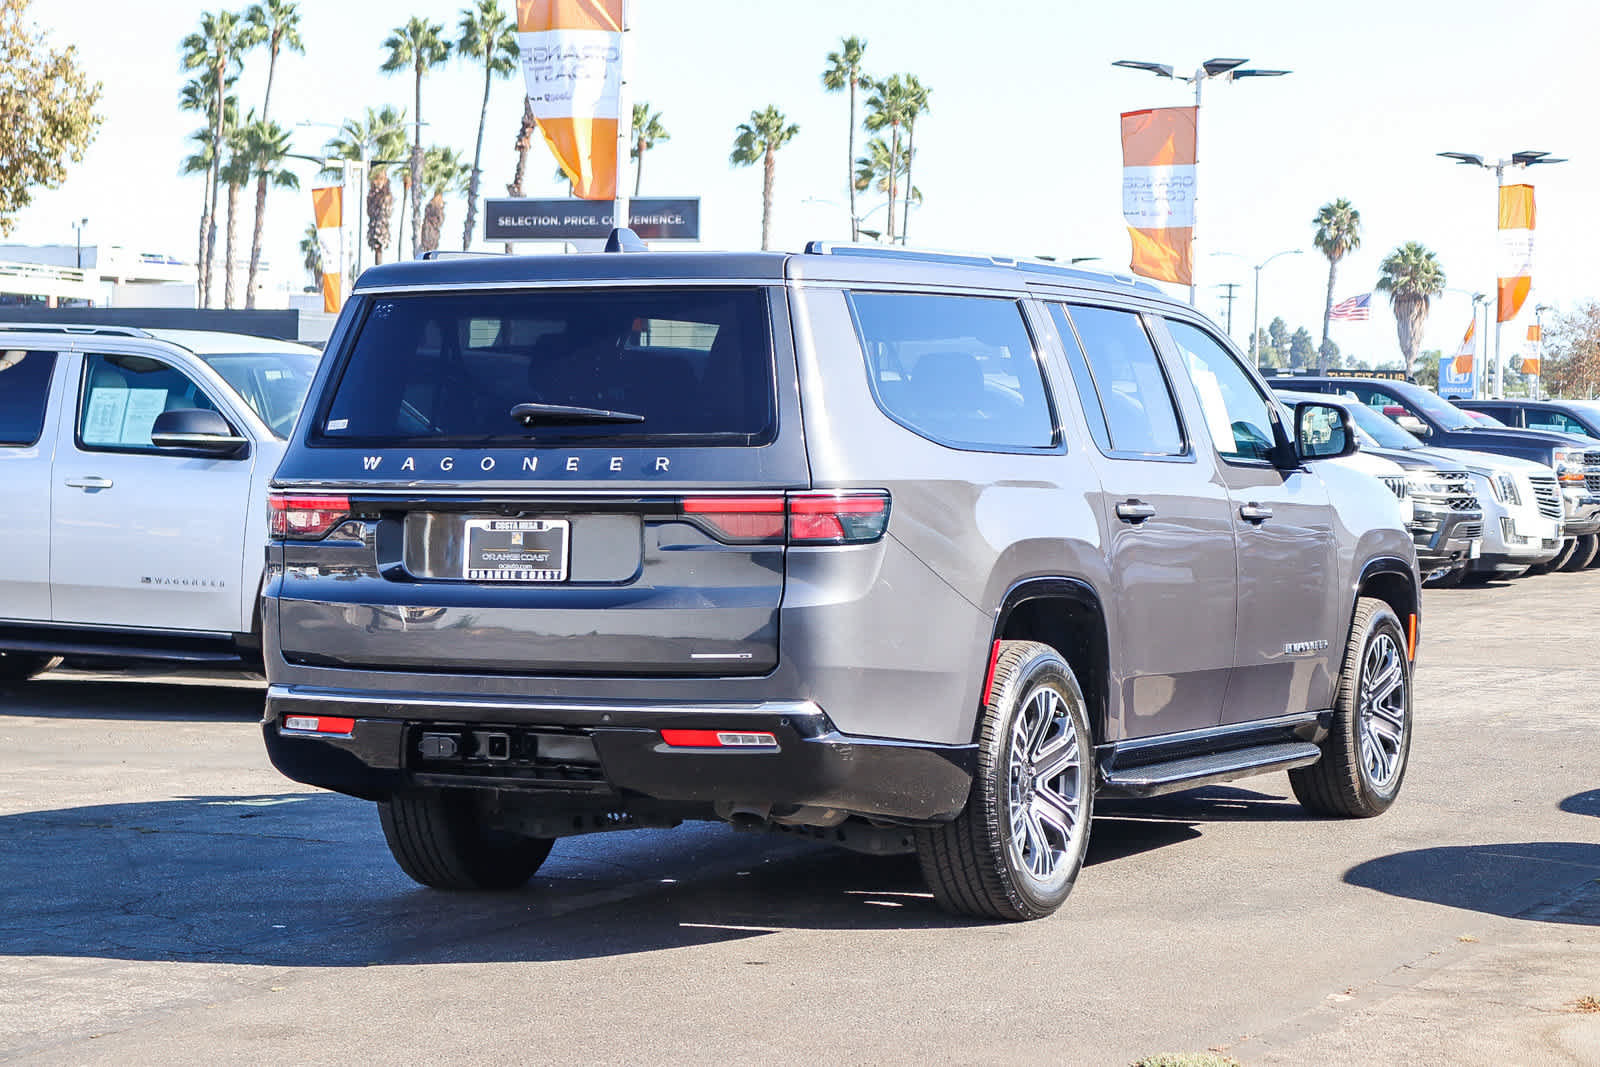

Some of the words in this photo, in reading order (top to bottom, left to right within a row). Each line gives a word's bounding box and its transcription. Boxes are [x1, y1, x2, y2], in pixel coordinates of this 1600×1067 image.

[498, 216, 561, 226] SELECTION.
[564, 216, 599, 226] PRICE.
[363, 456, 671, 471] WAGONEER
[521, 553, 551, 562] COAST
[470, 570, 517, 580] ORANGE
[521, 570, 560, 580] COAST
